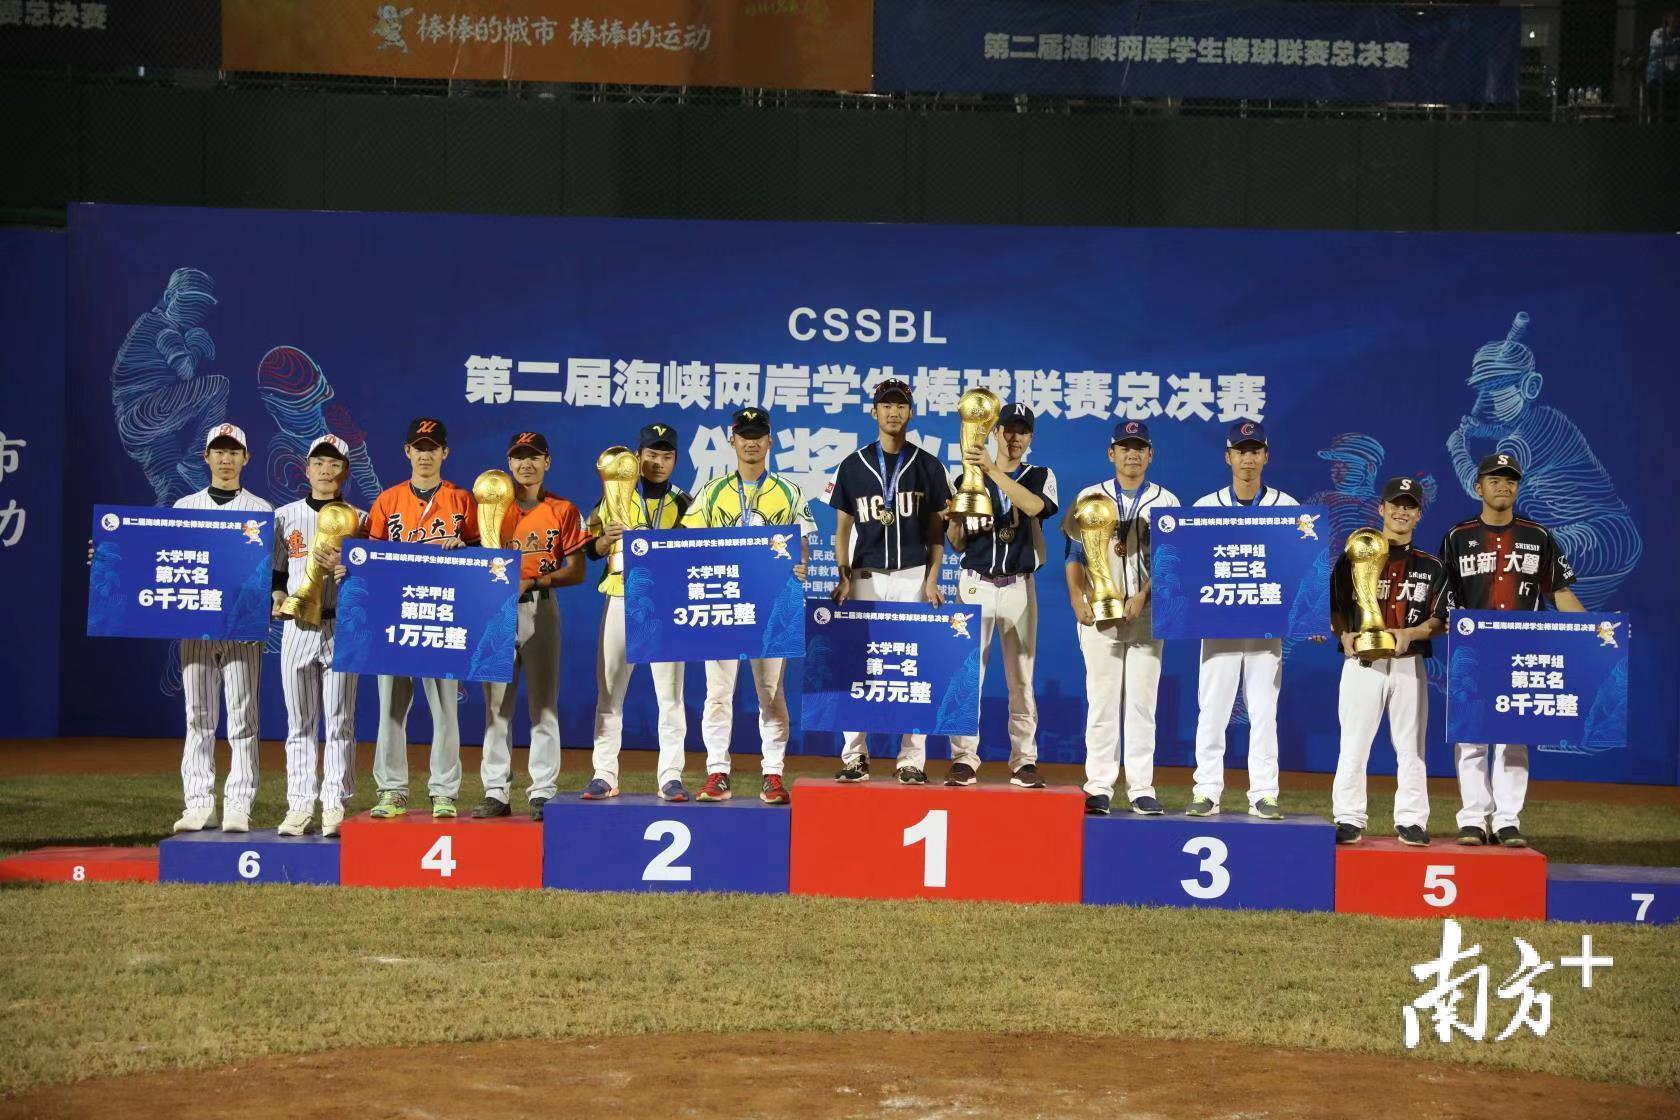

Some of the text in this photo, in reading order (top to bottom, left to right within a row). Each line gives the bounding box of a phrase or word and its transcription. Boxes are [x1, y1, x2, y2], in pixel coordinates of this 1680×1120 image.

[416, 13, 712, 52] 棒棒的城市 棒棒的运动
[983, 32, 1410, 68] 第二届海峡两岸学生棒球联赛总决赛
[788, 307, 948, 345] CSSBL
[1013, 403, 1026, 416] N
[1497, 454, 1510, 466] S
[1399, 478, 1412, 491] S
[123, 517, 242, 530] 第二届海峡两岸学生棒球联赛总决赛
[1178, 517, 1296, 527] 第二届海峡两岸学生棒球联赛总决赛
[651, 537, 769, 549] 第二届海峡两岸学生棒球联赛总决赛
[1213, 544, 1266, 558] 大学甲组
[156, 550, 210, 564] 大学甲组
[370, 551, 489, 567] 第二届海峡两岸学生棒球联赛总决赛
[155, 565, 209, 585] 第六名
[687, 565, 740, 580] 大学甲组
[1213, 561, 1267, 579] 第三名
[138, 587, 223, 612] 6千元整
[402, 584, 456, 601] 大学甲组
[687, 581, 741, 600] 第二名
[1199, 582, 1283, 606] 2万元整
[401, 602, 454, 622] 第四名
[673, 602, 757, 628] 3万元整
[833, 611, 950, 623] 第二届海峡两岸学生棒球联赛总决赛
[1477, 621, 1596, 632] 第二届海峡两岸学生棒球联赛总决赛
[385, 623, 468, 650] 1万元整
[866, 641, 919, 657] 大学甲组
[866, 657, 918, 677] 第一名
[1511, 654, 1565, 669] 大学甲组
[1511, 671, 1564, 689] 第五名
[850, 679, 932, 704] 5万元整
[1494, 693, 1579, 717] 8千元整
[421, 835, 457, 877] 4
[641, 819, 692, 881] 2
[903, 809, 948, 888] 1
[73, 865, 85, 881] 8
[238, 851, 261, 878] 6
[1180, 836, 1231, 899] 3
[1422, 865, 1458, 907] 5
[1631, 893, 1655, 921] 7
